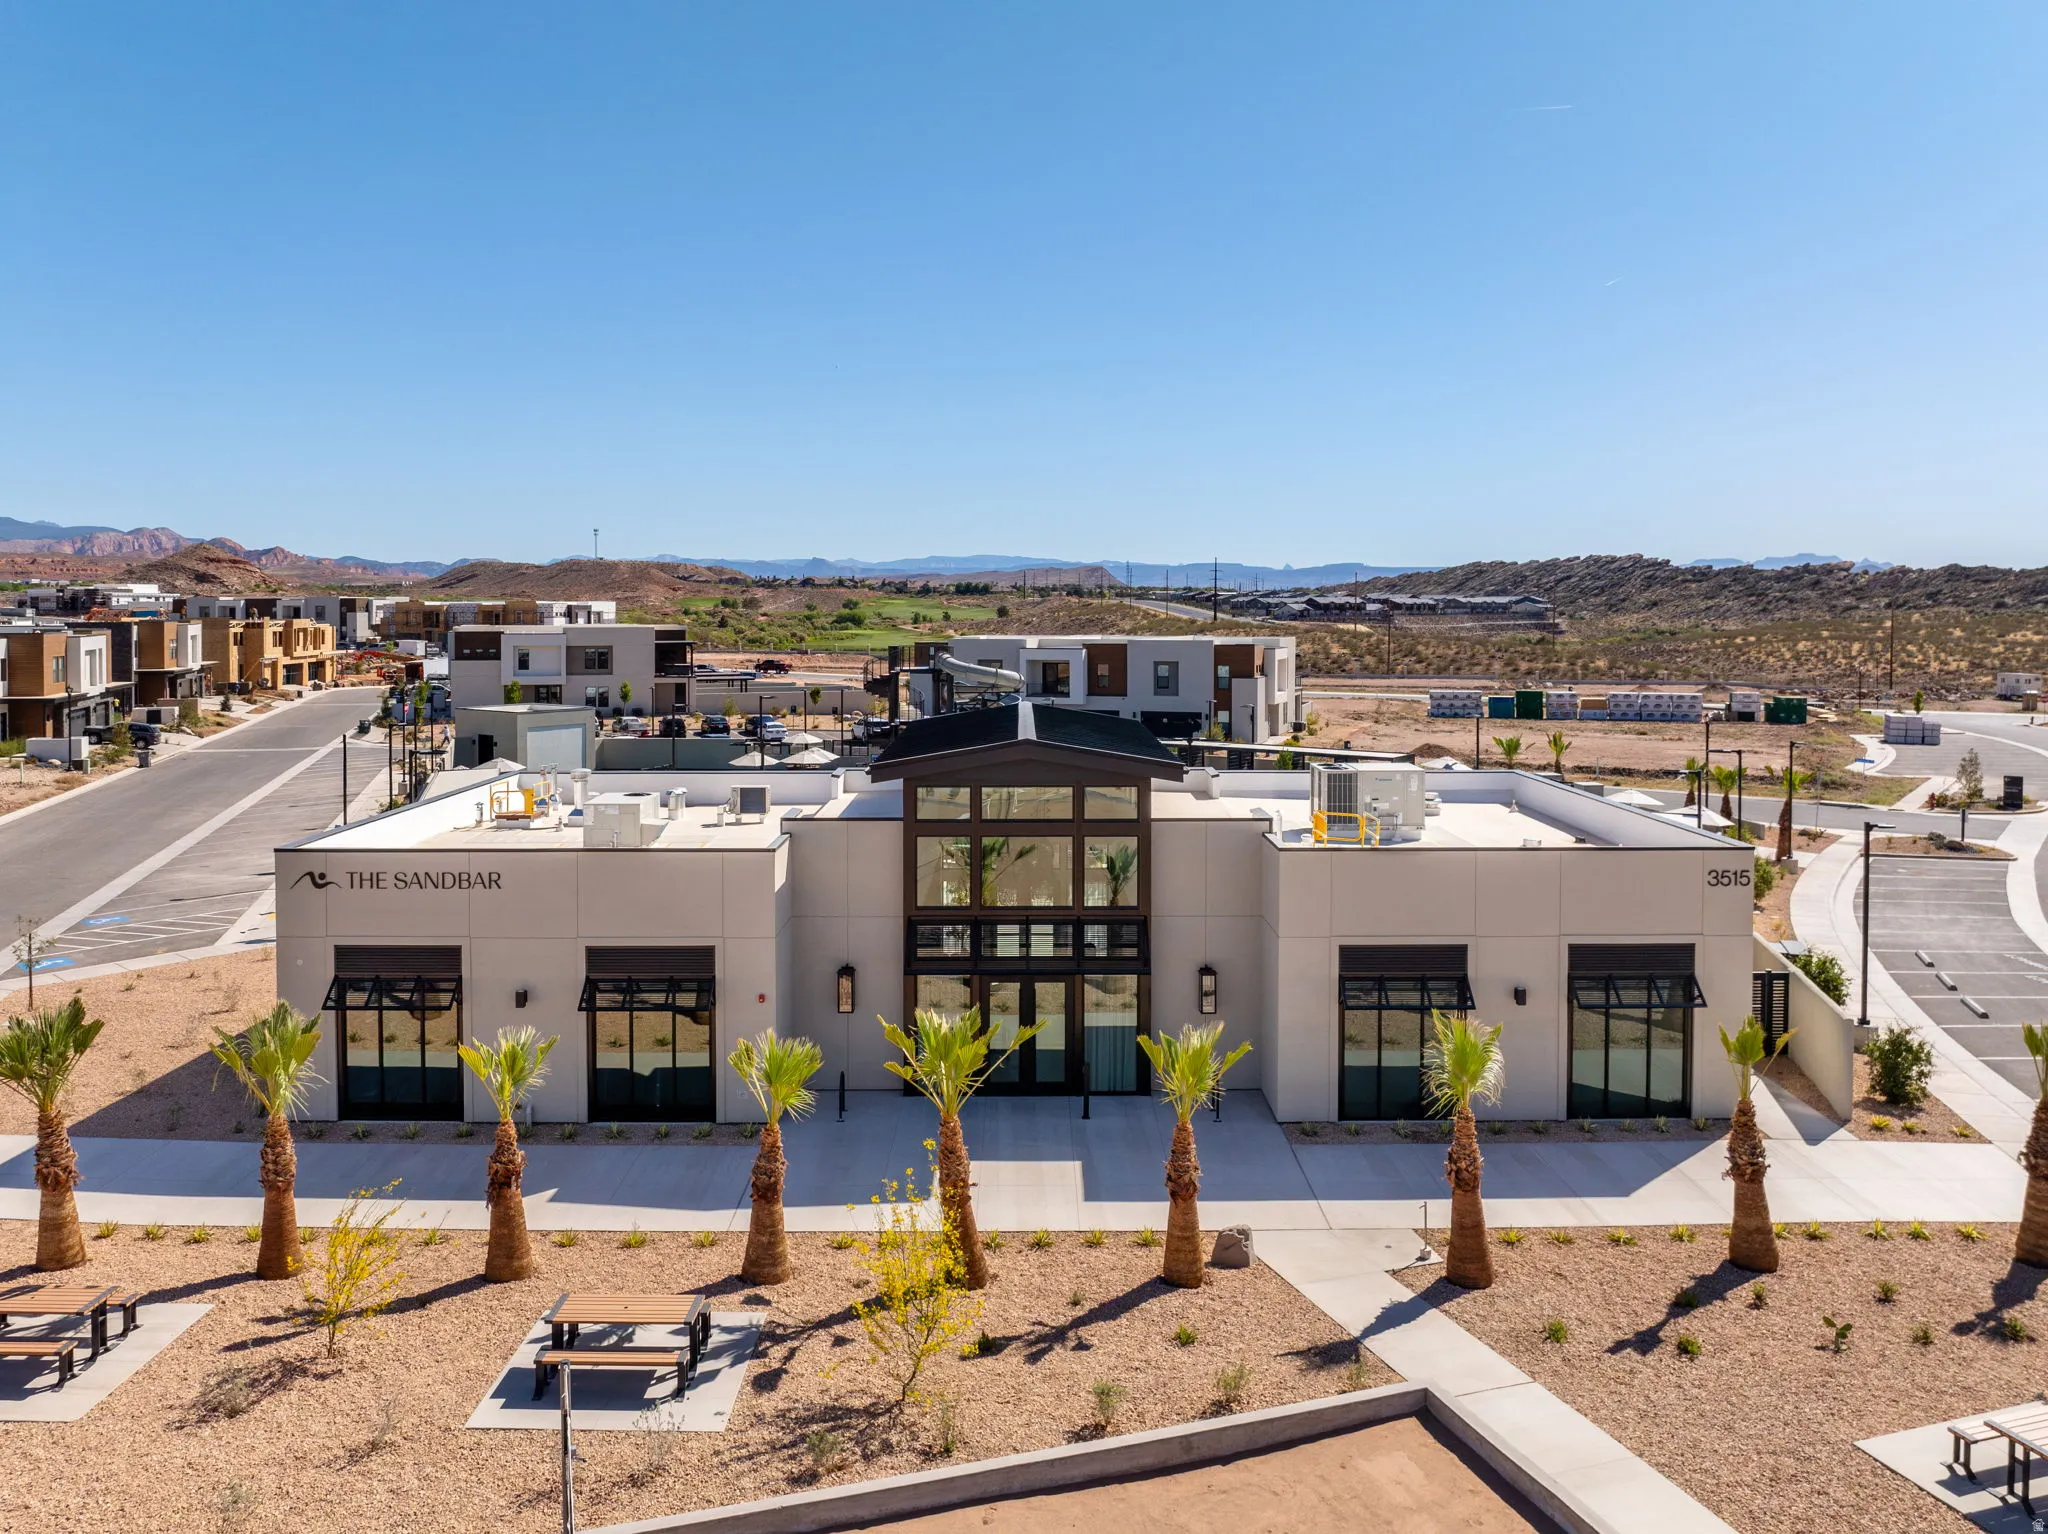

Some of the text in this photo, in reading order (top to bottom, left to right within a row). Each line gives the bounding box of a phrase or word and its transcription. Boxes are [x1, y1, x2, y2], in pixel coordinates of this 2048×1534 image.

[346, 871, 502, 890] THE SANDBAR
[1707, 869, 1751, 887] 3515
